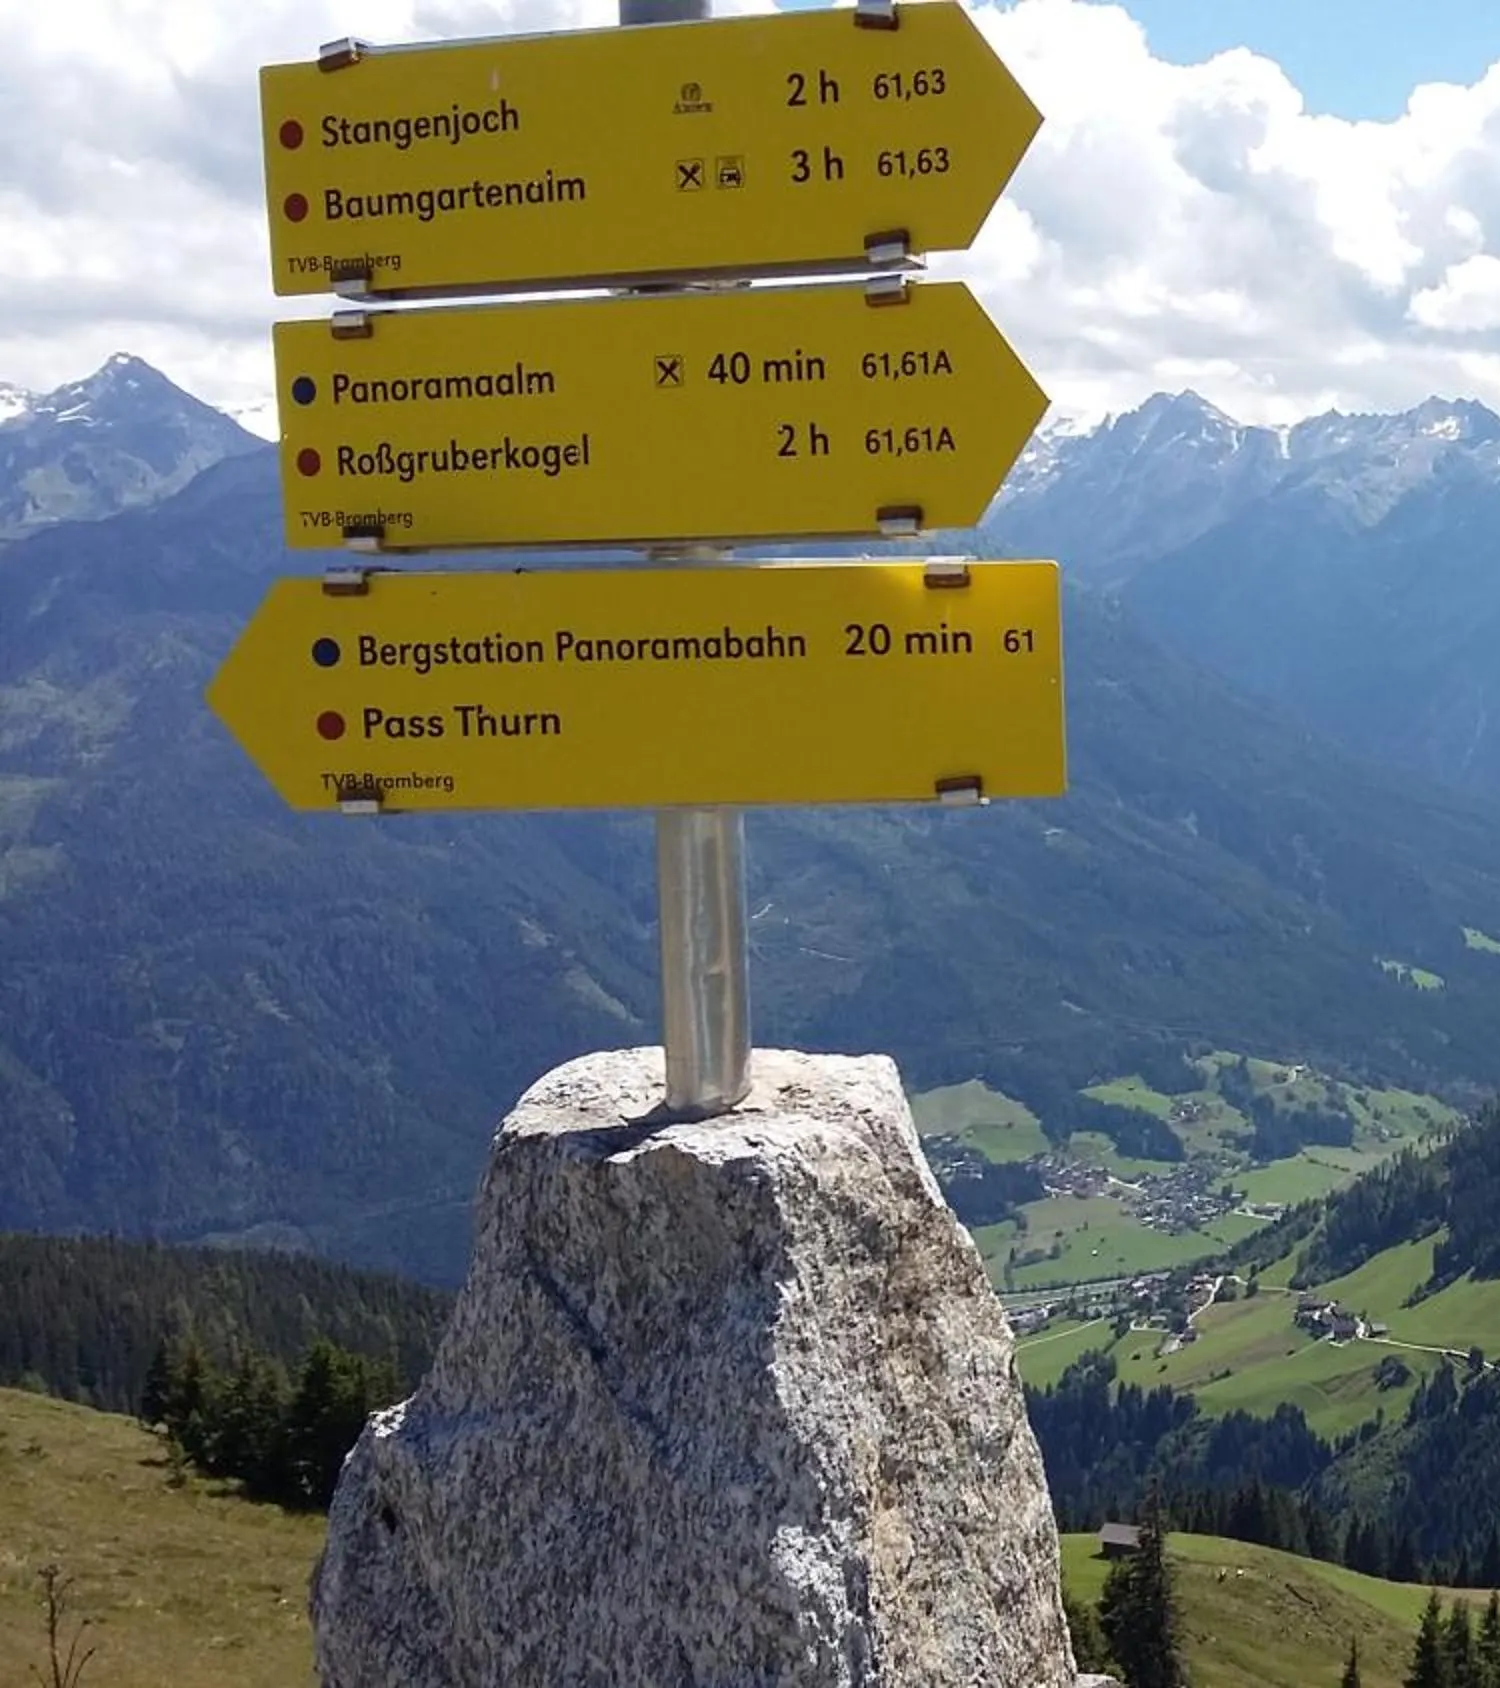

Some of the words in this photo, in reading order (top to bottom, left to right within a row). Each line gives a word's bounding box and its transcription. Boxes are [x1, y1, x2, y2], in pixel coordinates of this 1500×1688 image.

[321, 99, 519, 150] Stangenjoch
[787, 73, 807, 107] 2
[819, 70, 840, 104] h
[873, 69, 946, 101] 61,63
[791, 149, 811, 183] 3
[824, 146, 844, 181] h
[877, 147, 950, 179] 61,63
[287, 252, 401, 273] TVB-Bramberg
[332, 362, 556, 404] Panoramaalm
[707, 350, 751, 385] 40
[763, 349, 826, 383] min
[862, 350, 953, 381] 61,61A
[337, 433, 590, 482] Roßgruberkogel
[777, 424, 797, 457] 2
[809, 422, 830, 455] h
[865, 427, 956, 458] 61,61A
[300, 508, 413, 528] TVB-Bramberg
[359, 633, 544, 675] Bergstation
[556, 625, 807, 662] Panoramabahn
[845, 623, 891, 655] 20
[905, 622, 973, 655] min
[1003, 629, 1034, 653] 61
[363, 708, 445, 739] Pass
[453, 703, 562, 737] Thurn
[320, 771, 455, 793] TVB-Bramberg
